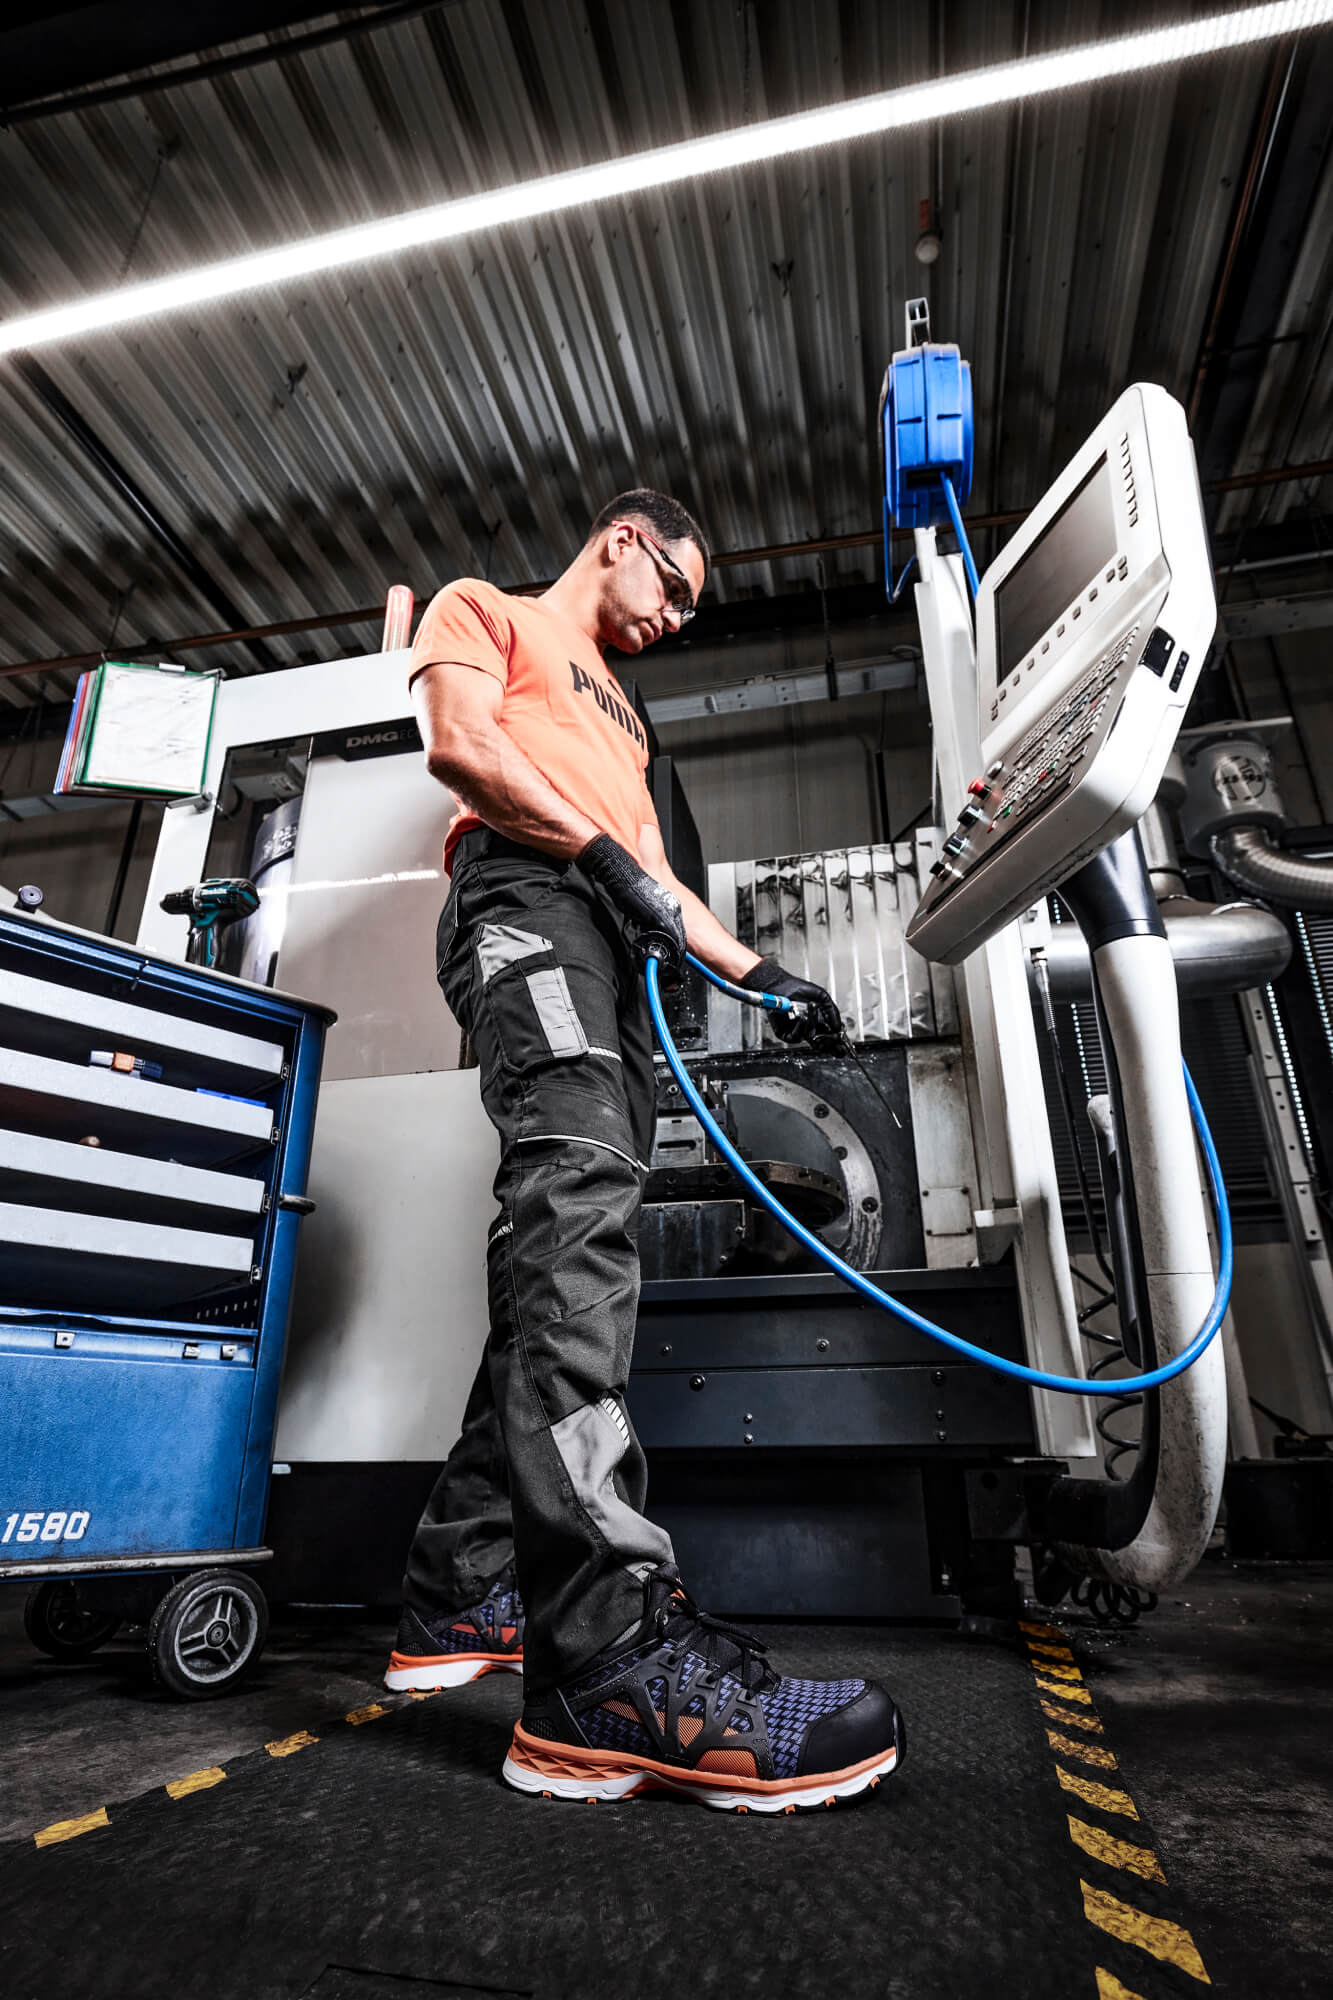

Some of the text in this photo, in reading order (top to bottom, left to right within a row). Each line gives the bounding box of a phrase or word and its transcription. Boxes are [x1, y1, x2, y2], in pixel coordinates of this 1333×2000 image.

[568, 660, 645, 752] PUMA
[346, 731, 399, 748] DMG
[1, 1511, 90, 1543] 1580
